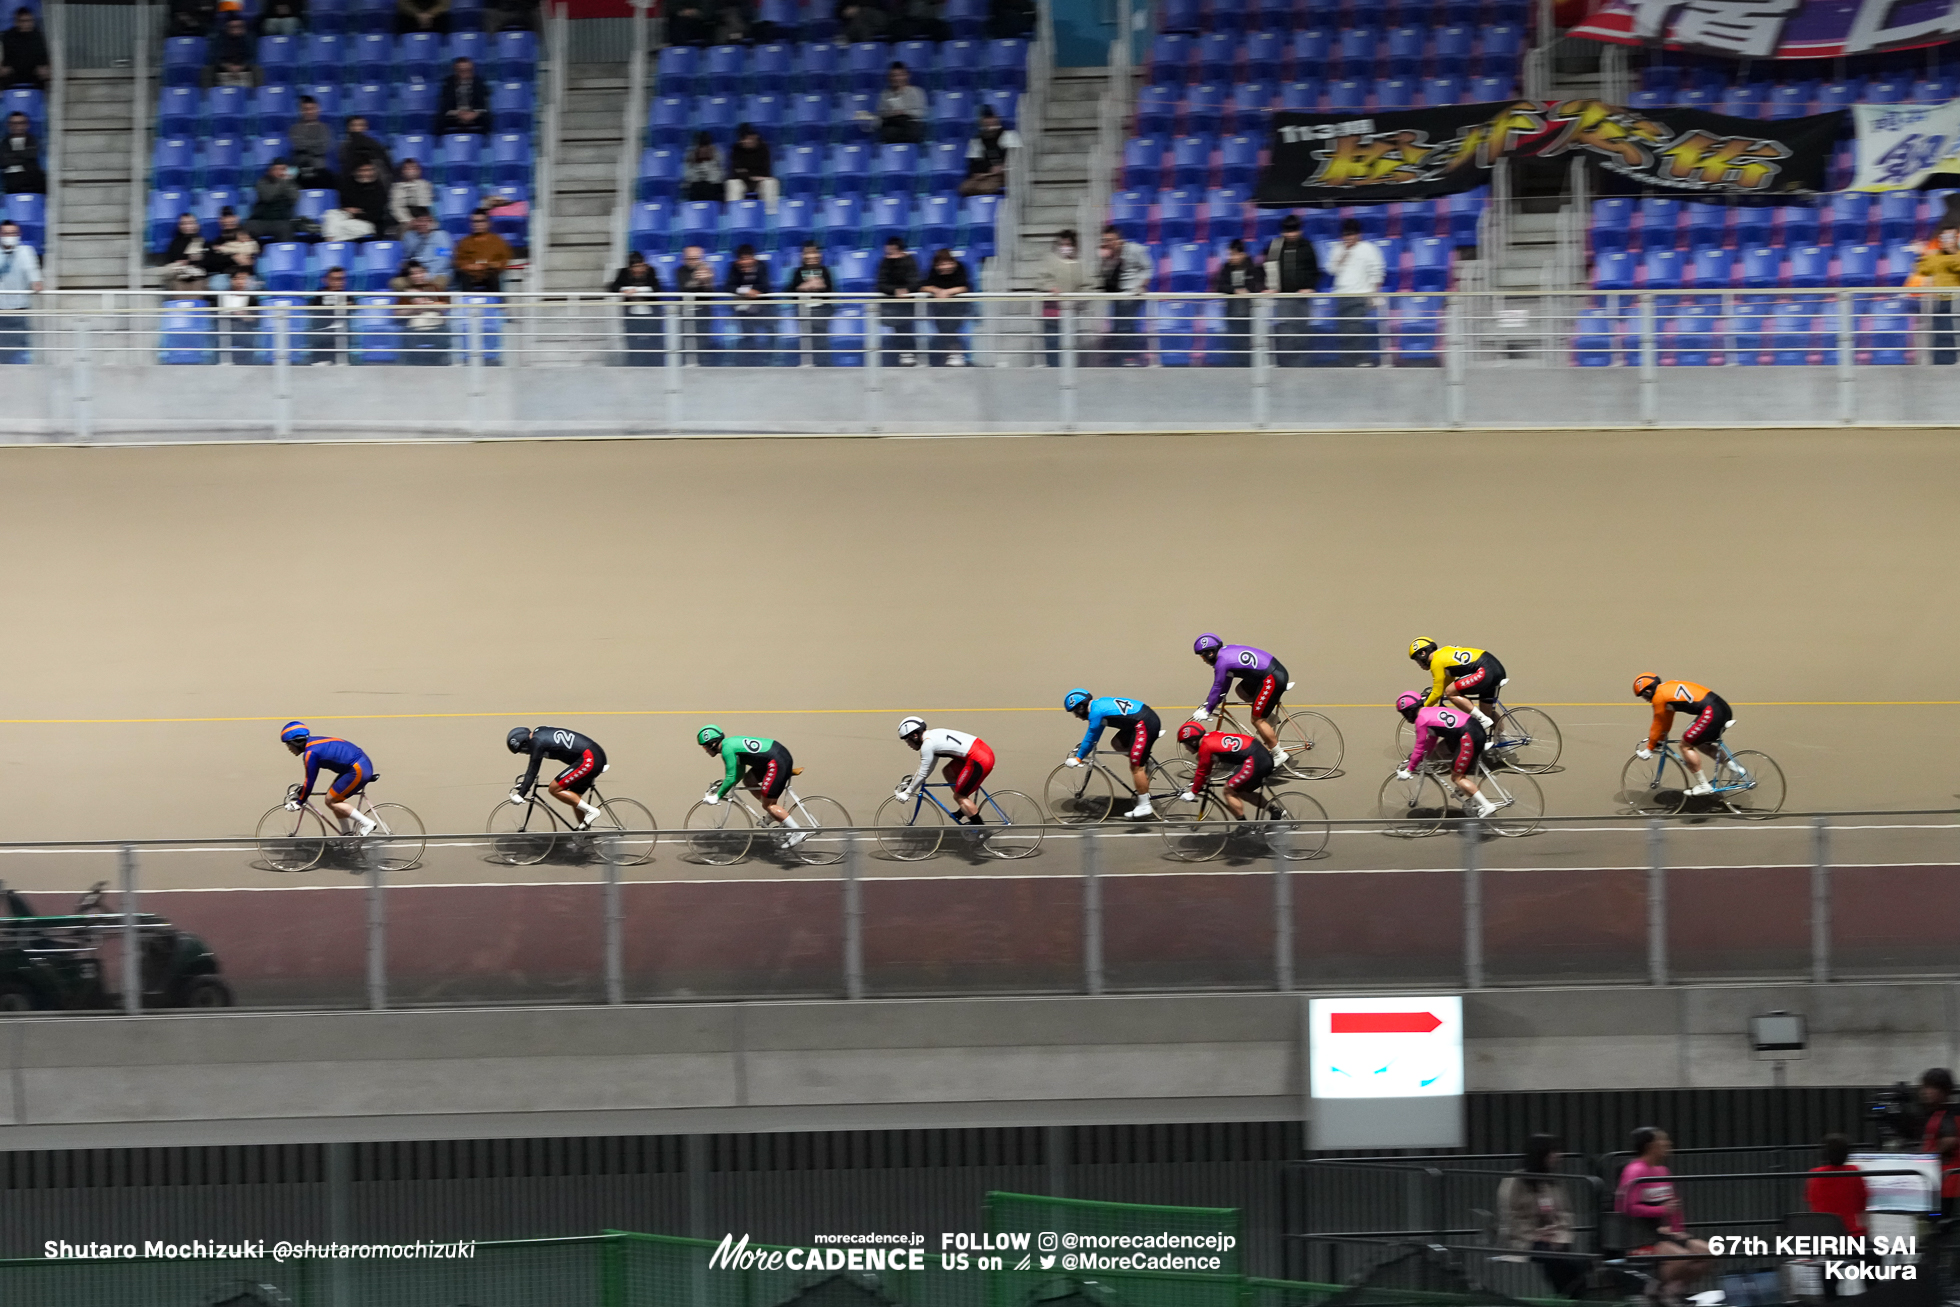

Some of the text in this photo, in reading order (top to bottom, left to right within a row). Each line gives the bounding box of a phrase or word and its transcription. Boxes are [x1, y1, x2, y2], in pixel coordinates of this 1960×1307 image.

[1200, 637, 1208, 648] 9
[1412, 640, 1420, 651] 5
[1238, 650, 1258, 669] 9
[1453, 650, 1473, 665] 5
[1636, 679, 1644, 691] 7
[1068, 695, 1076, 707] 4
[1674, 683, 1694, 704] 7
[1113, 698, 1134, 716] 4
[1437, 710, 1458, 728] 8
[553, 729, 576, 749] 2
[703, 730, 710, 741] 6
[946, 734, 962, 746] 1
[1182, 727, 1191, 738] 3
[742, 737, 762, 753] 6
[1222, 735, 1243, 752] 3
